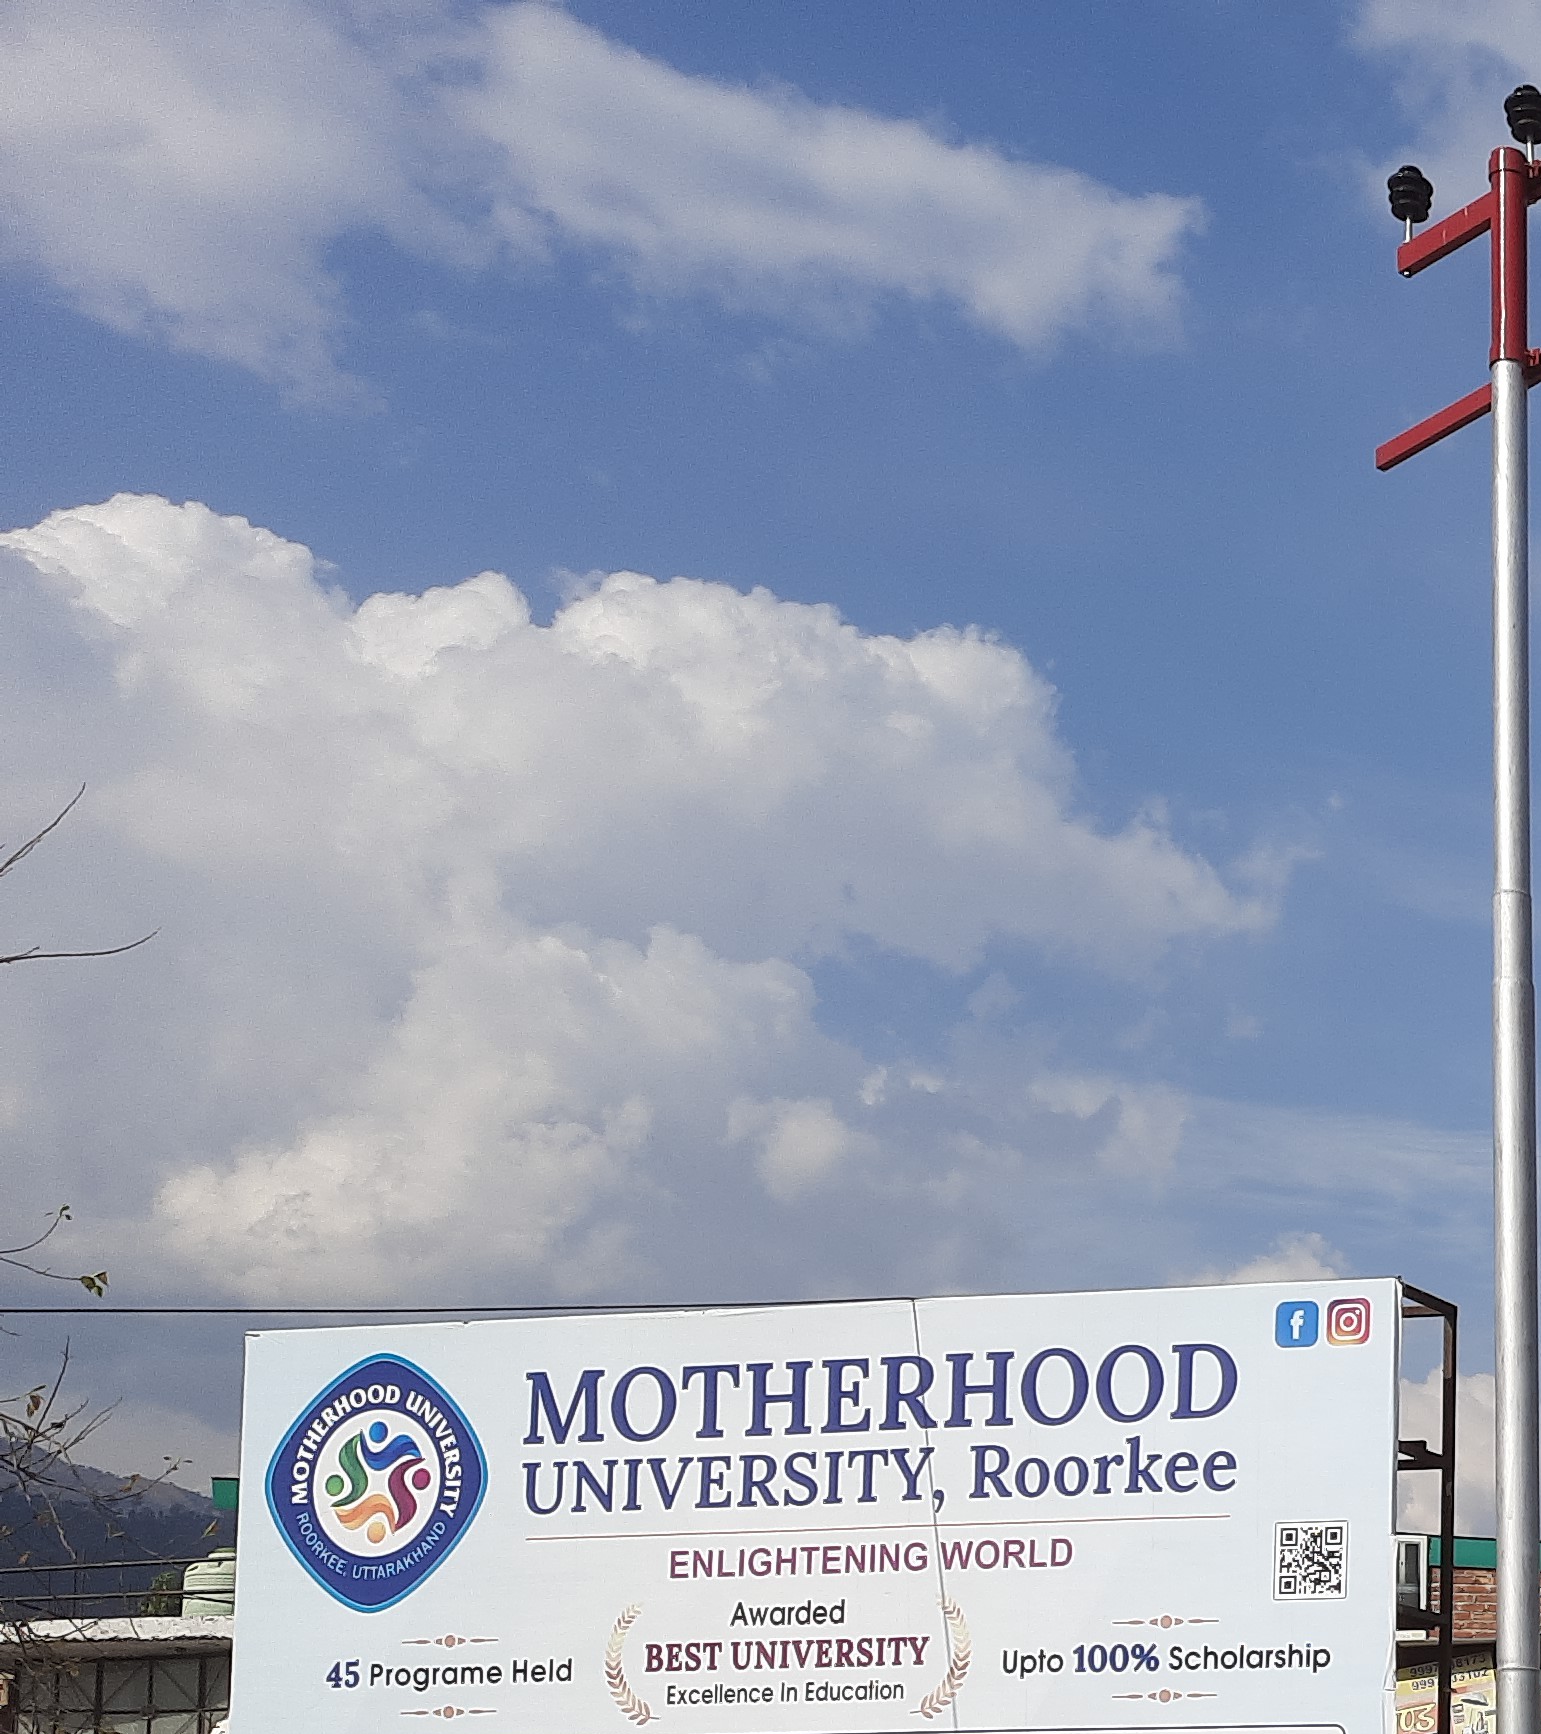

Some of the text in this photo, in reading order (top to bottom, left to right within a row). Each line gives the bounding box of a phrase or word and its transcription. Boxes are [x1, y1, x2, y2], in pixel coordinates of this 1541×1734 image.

[522, 1343, 1239, 1446] MOTHERHOOD
[291, 1382, 460, 1520] MOTHERHOOD UNIVERSITY
[521, 1436, 1238, 1515] UNIVERSITY, Roorkee
[351, 1520, 448, 1582] UTTARAKHAND
[668, 1537, 1074, 1580] ENLIGHTENING WORLD
[730, 1599, 846, 1629] Awarded
[325, 1658, 574, 1689] 45 Programe Held
[644, 1636, 930, 1674] BEST UNIVERSITY
[1002, 1642, 1332, 1677] Upto 100% Scholarship
[666, 1680, 905, 1706] Excellence In Education
